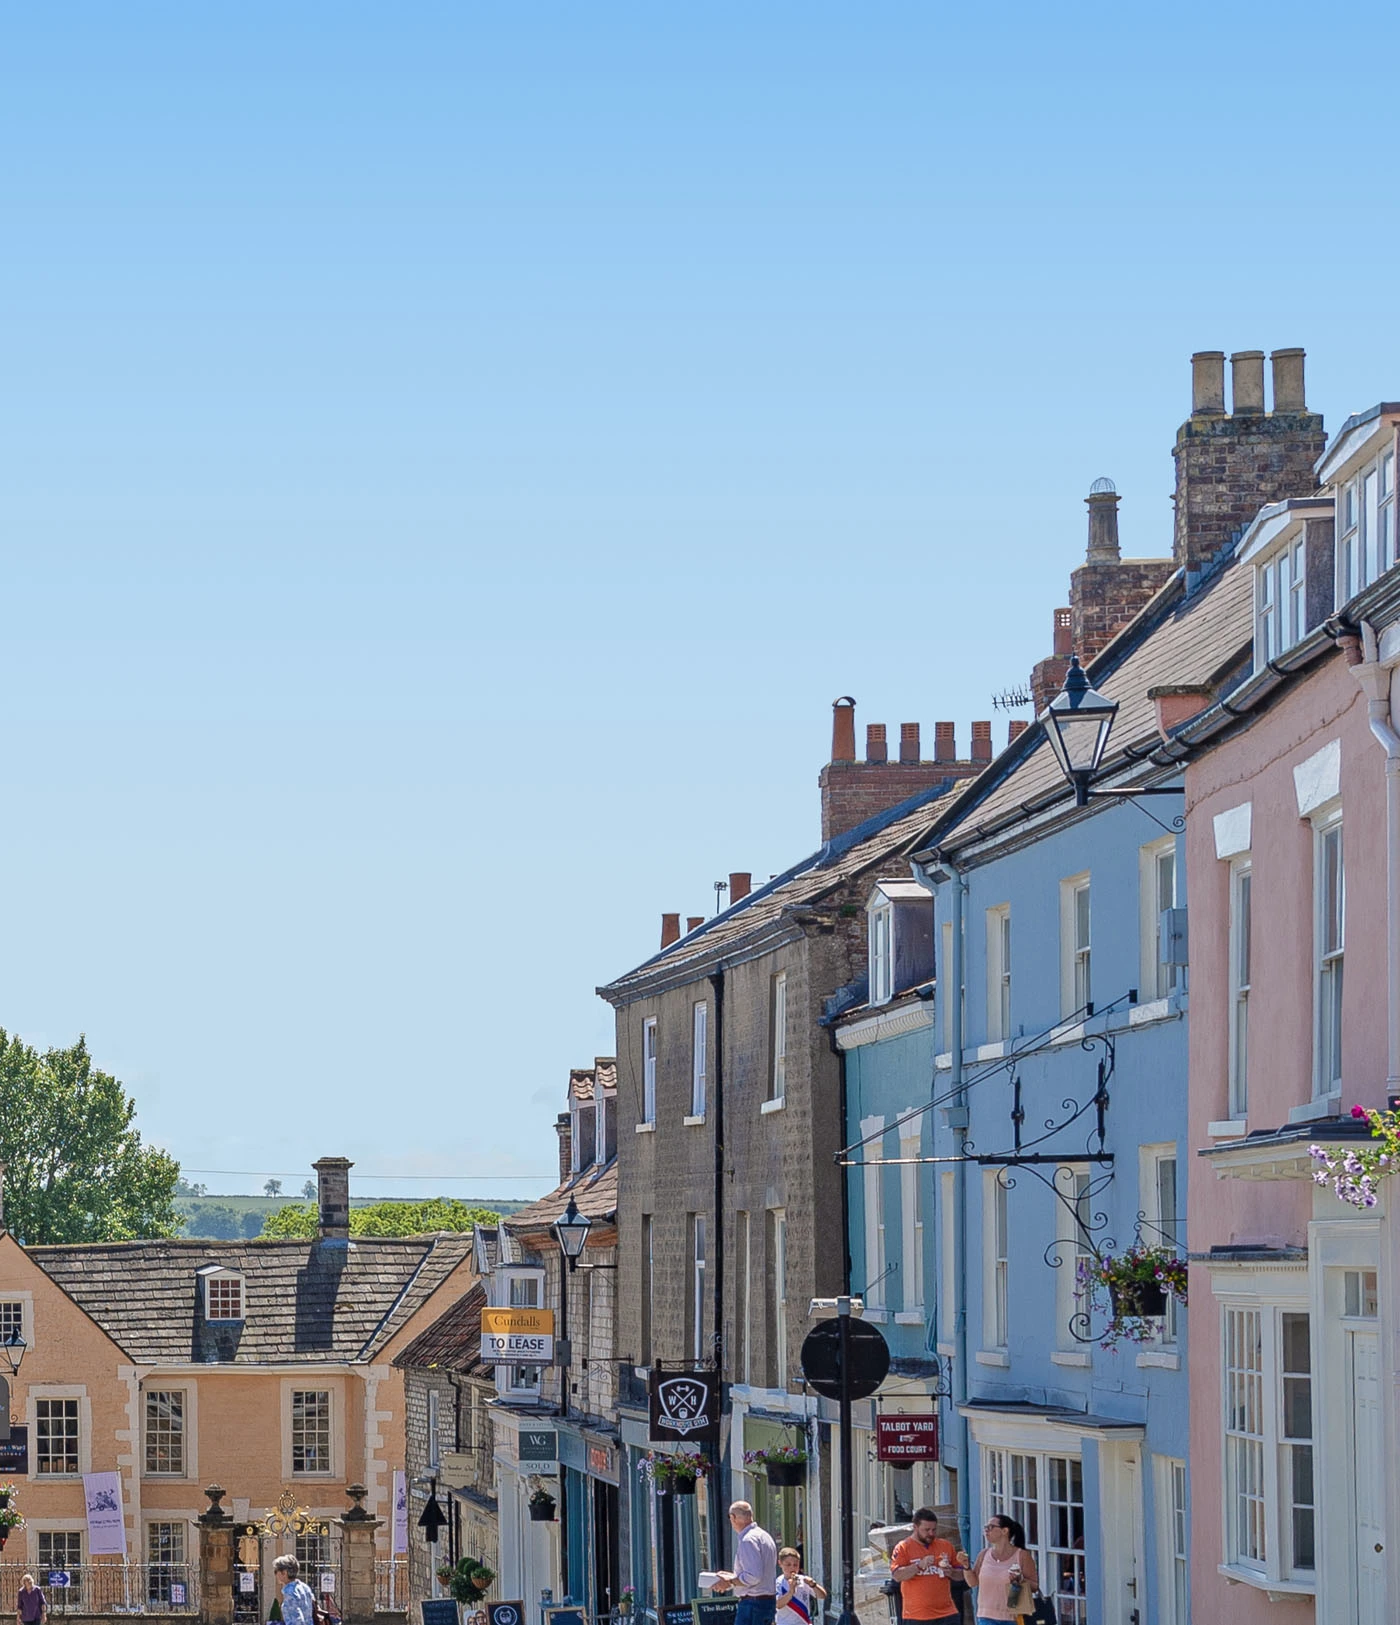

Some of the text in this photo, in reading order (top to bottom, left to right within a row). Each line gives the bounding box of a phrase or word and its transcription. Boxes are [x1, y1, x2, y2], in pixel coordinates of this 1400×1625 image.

[489, 1337, 545, 1350] TO LEASE
[881, 1422, 934, 1431] TALBOT YARD
[888, 1445, 927, 1454] FOOD COURT
